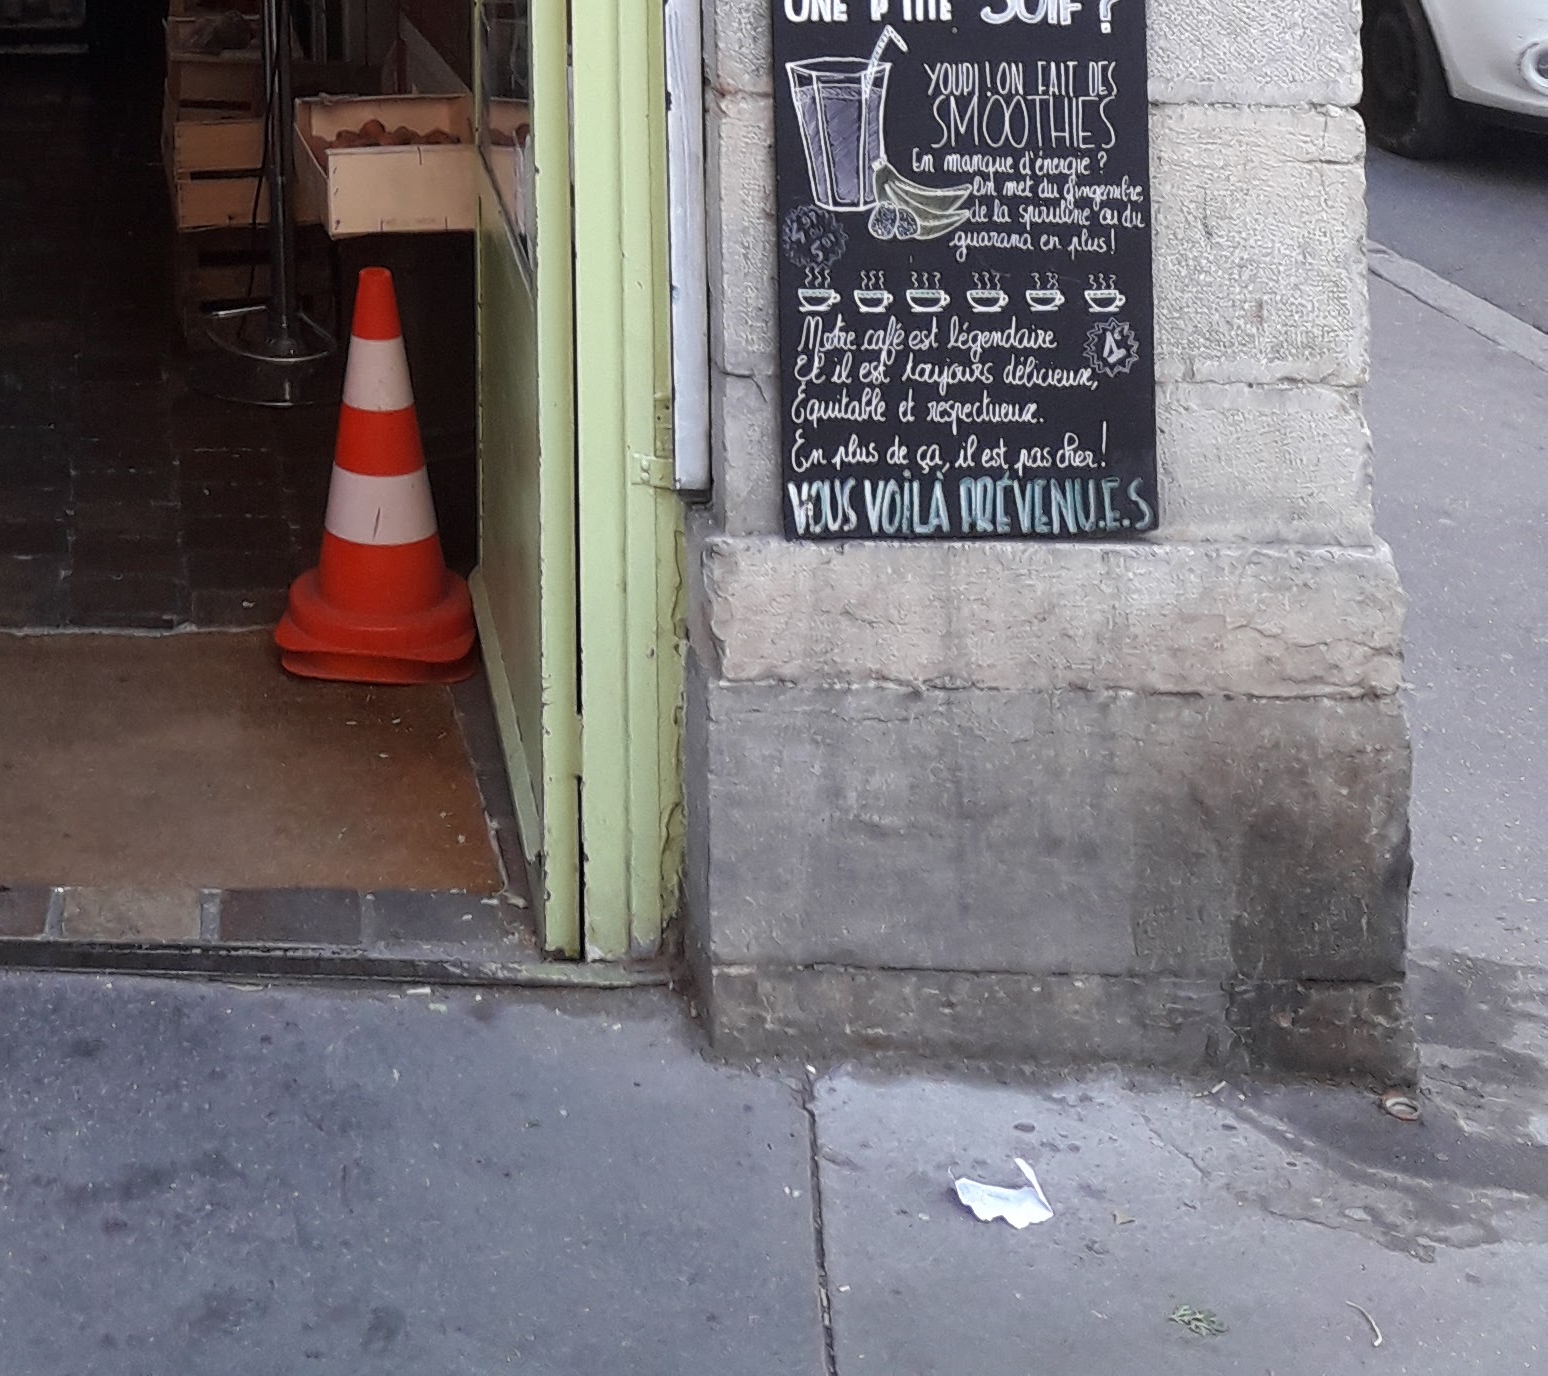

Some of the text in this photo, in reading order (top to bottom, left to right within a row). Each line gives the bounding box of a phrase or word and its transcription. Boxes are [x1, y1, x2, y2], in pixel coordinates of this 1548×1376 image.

[996, 61, 1118, 96] ON FAIT DES
[930, 94, 1117, 149] SMOOTHIES
[911, 149, 1092, 186] En manque d'énergie
[972, 176, 1060, 199] On met du
[968, 199, 1146, 233] de la spiruline ou du
[948, 231, 1060, 263] guarana en
[861, 314, 905, 366] café
[908, 315, 939, 351] est
[947, 315, 1058, 364] légendaire
[830, 351, 994, 397] il est toujours
[898, 387, 916, 423] et
[790, 428, 1052, 477] En plus de il est pas
[786, 476, 857, 536] VOUS
